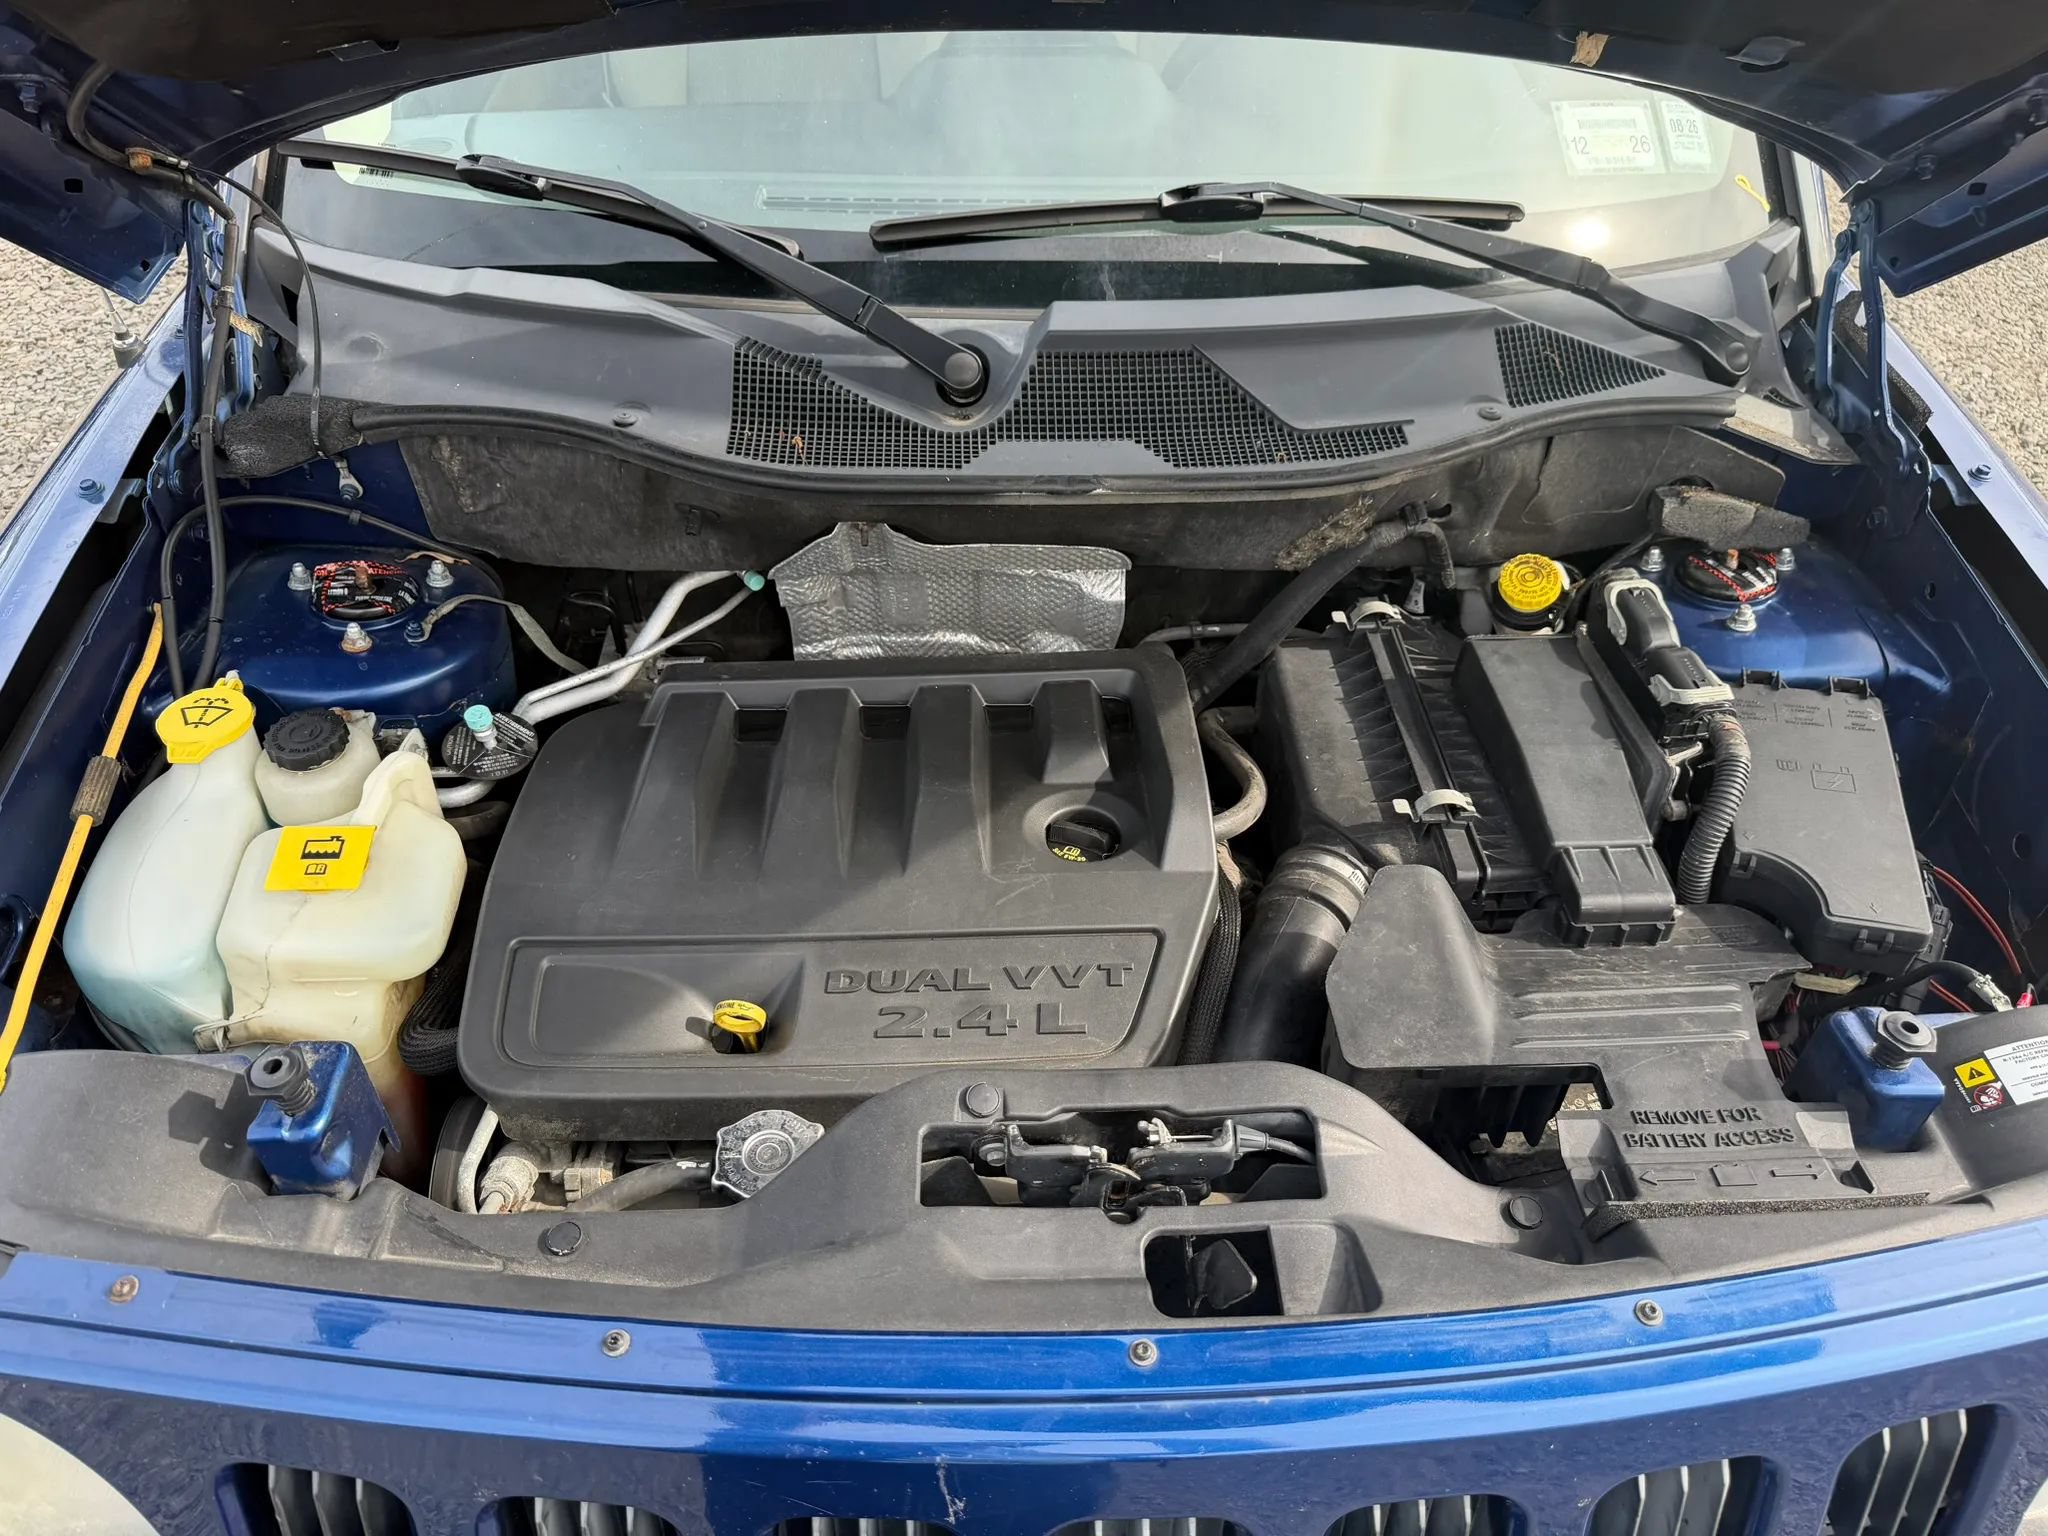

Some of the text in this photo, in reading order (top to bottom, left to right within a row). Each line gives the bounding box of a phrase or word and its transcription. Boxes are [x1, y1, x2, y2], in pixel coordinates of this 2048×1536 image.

[1687, 119, 1699, 134] 26
[1570, 136, 1591, 155] 12
[1629, 135, 1651, 153] 26
[824, 962, 1135, 994] DUAL VVT
[1630, 1107, 1762, 1126] REMOVE FOR
[1622, 1127, 1795, 1149] BATTERY ACCESS
